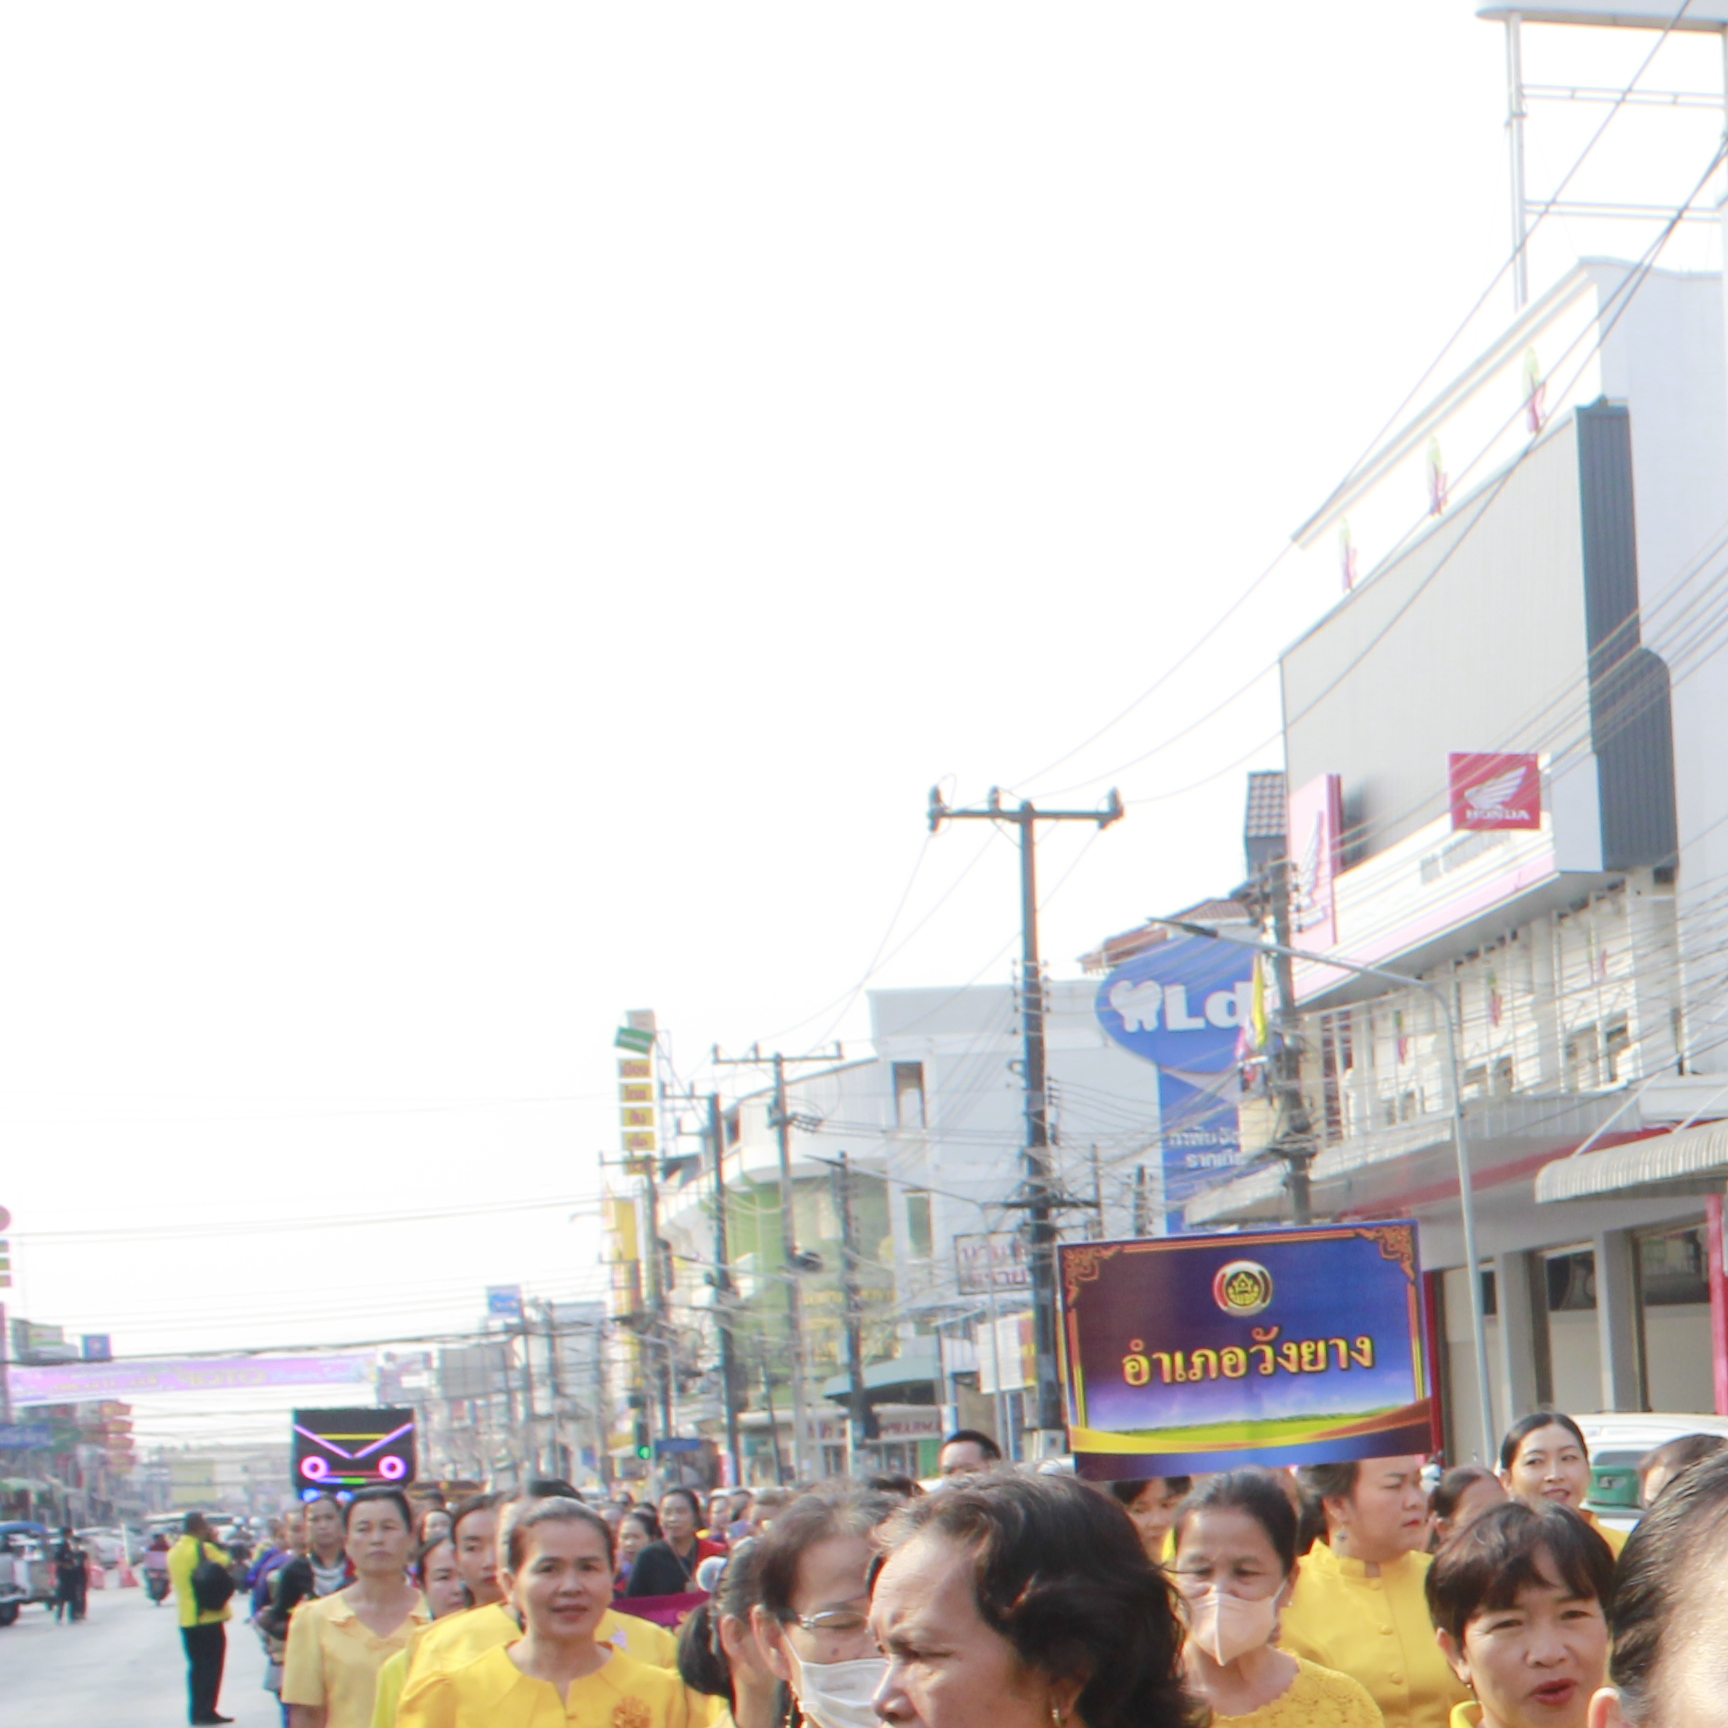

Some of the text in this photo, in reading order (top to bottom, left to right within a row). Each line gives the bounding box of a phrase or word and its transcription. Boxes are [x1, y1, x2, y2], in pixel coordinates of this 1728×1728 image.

[1465, 808, 1531, 822] HONDA
[1163, 981, 1254, 1032] Ld
[1122, 1326, 1374, 1388] อำเภอวังยาง
